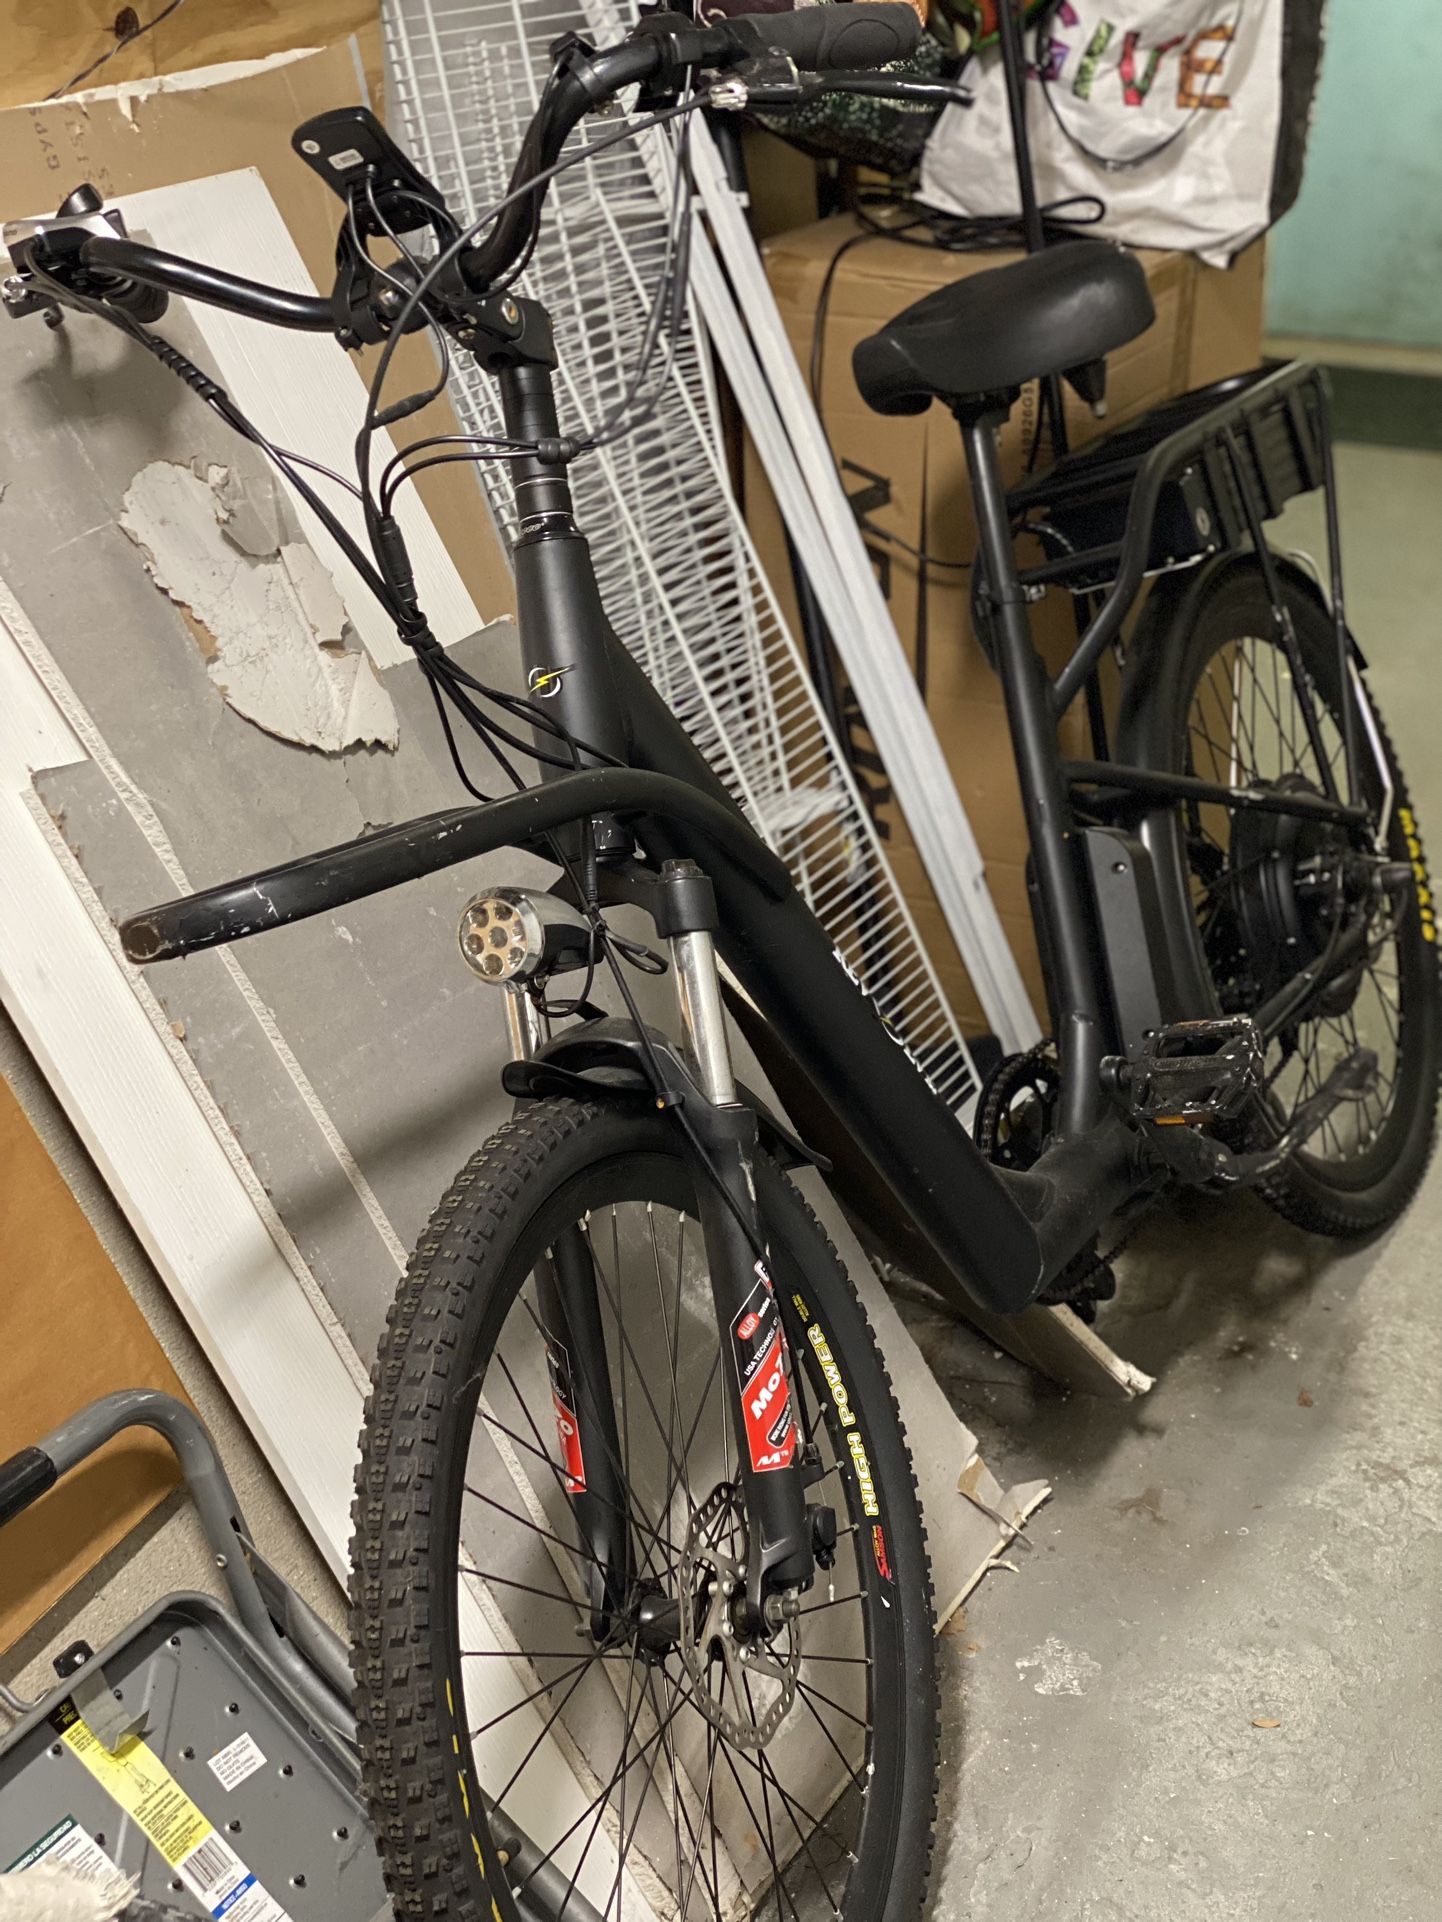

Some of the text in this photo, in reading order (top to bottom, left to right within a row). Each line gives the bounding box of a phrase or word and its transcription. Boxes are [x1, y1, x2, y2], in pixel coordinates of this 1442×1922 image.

[738, 1313, 759, 1338] ALLOY
[743, 1360, 757, 1376] USA
[807, 1322, 880, 1517] HIGH POWER
